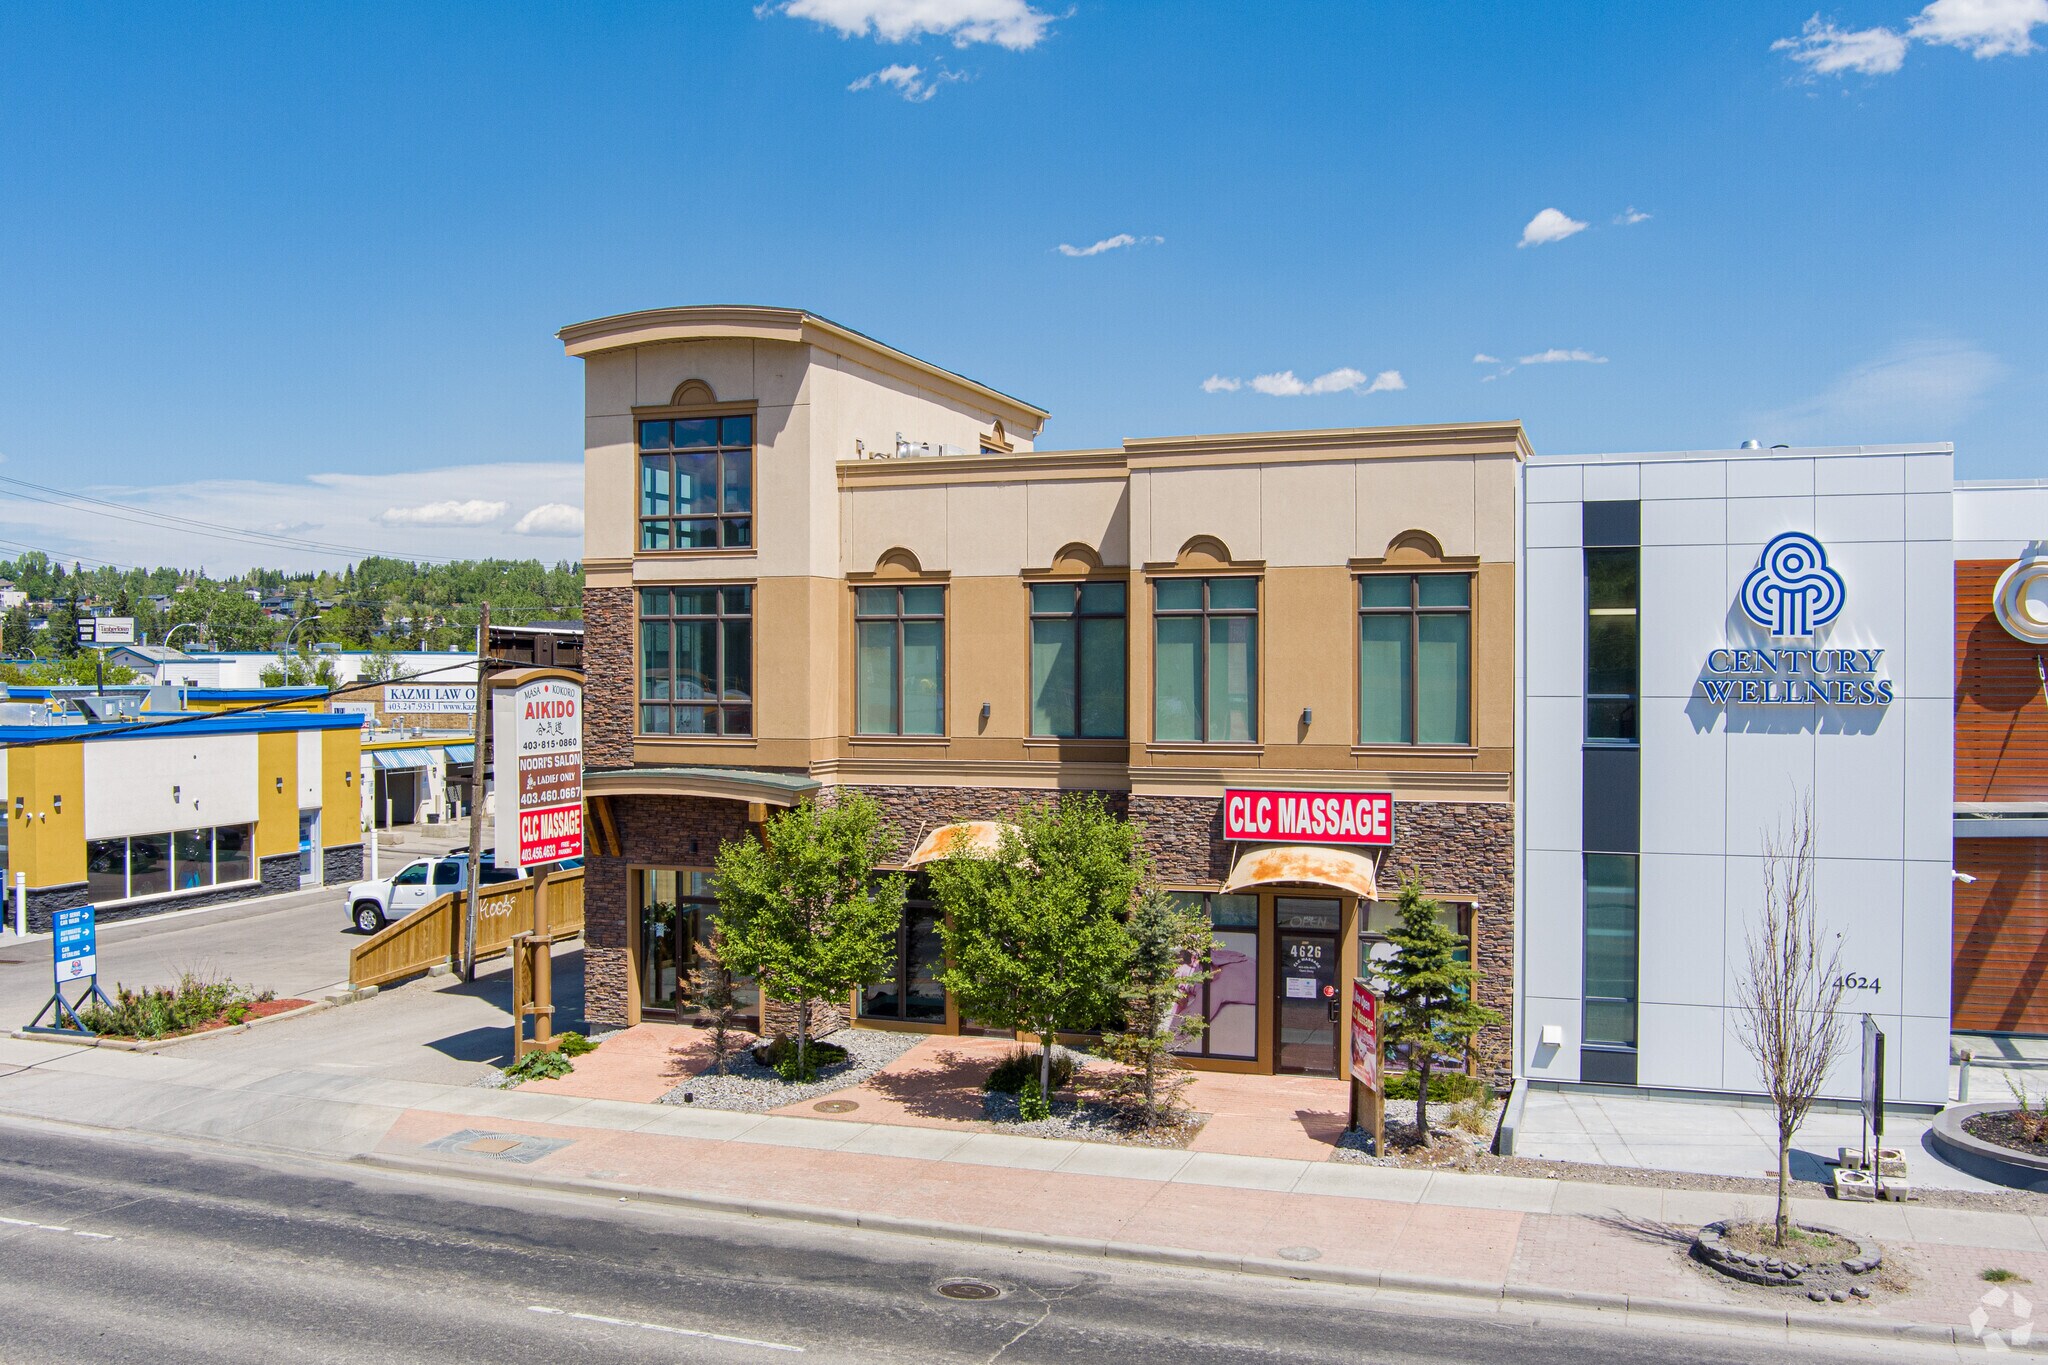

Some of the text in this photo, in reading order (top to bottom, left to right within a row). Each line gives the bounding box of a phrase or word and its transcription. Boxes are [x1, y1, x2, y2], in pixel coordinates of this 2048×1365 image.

[1707, 648, 1885, 675] CENTURY
[391, 688, 430, 700] KAZMI
[435, 688, 461, 700] LAW
[524, 685, 575, 699] MASA KOKORO
[1699, 679, 1894, 706] WELLNESS
[388, 701, 477, 711] 403.247.9331 www.kaz
[525, 700, 575, 720] AIKIDO
[520, 753, 580, 771] NOORI'S SALON
[537, 772, 576, 785] LADIES ONLY
[520, 787, 580, 805] 403.460.0667
[1229, 796, 1387, 836] CLC MASSAGE
[521, 809, 580, 843] CLC MASSAGE
[1290, 915, 1328, 928] OPEN
[1290, 945, 1321, 958] 4626
[1832, 971, 1882, 994] 4624
